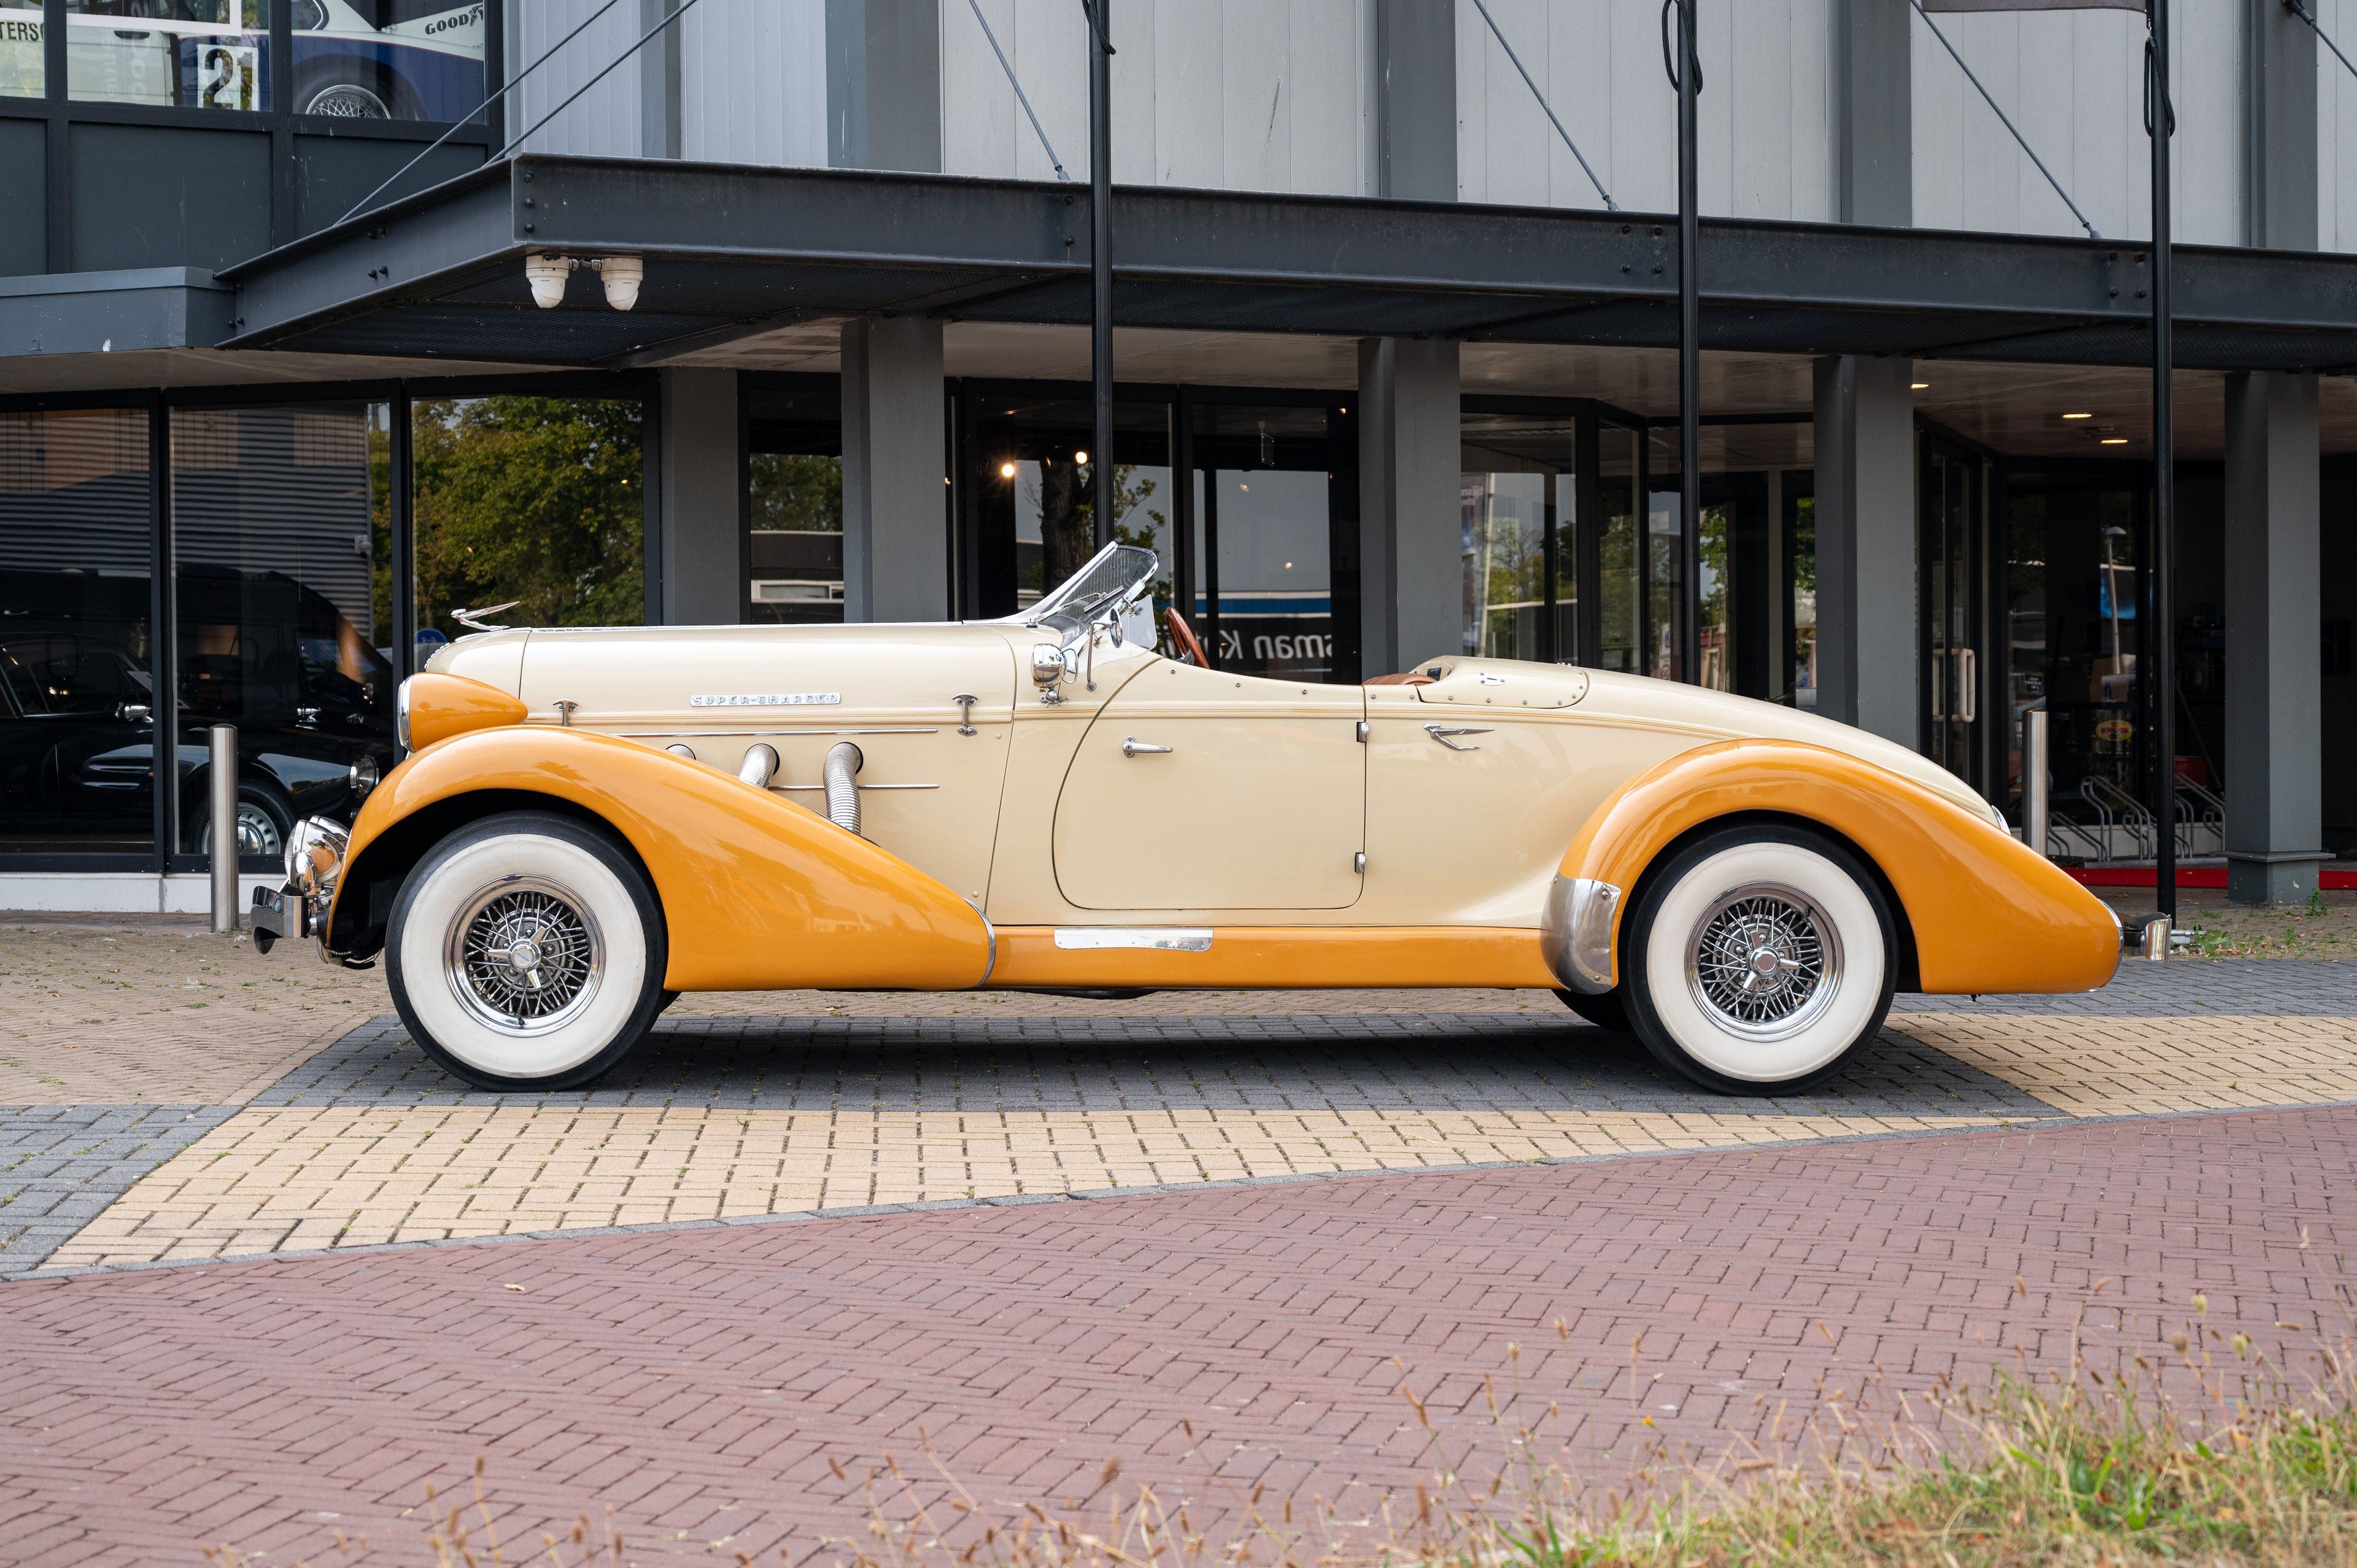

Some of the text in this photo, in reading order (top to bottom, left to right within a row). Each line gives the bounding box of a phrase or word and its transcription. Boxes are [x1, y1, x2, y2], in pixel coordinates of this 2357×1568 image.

[0, 21, 44, 41] TERS
[203, 48, 252, 110] 21
[692, 693, 838, 705] SUPER-CHARGED
